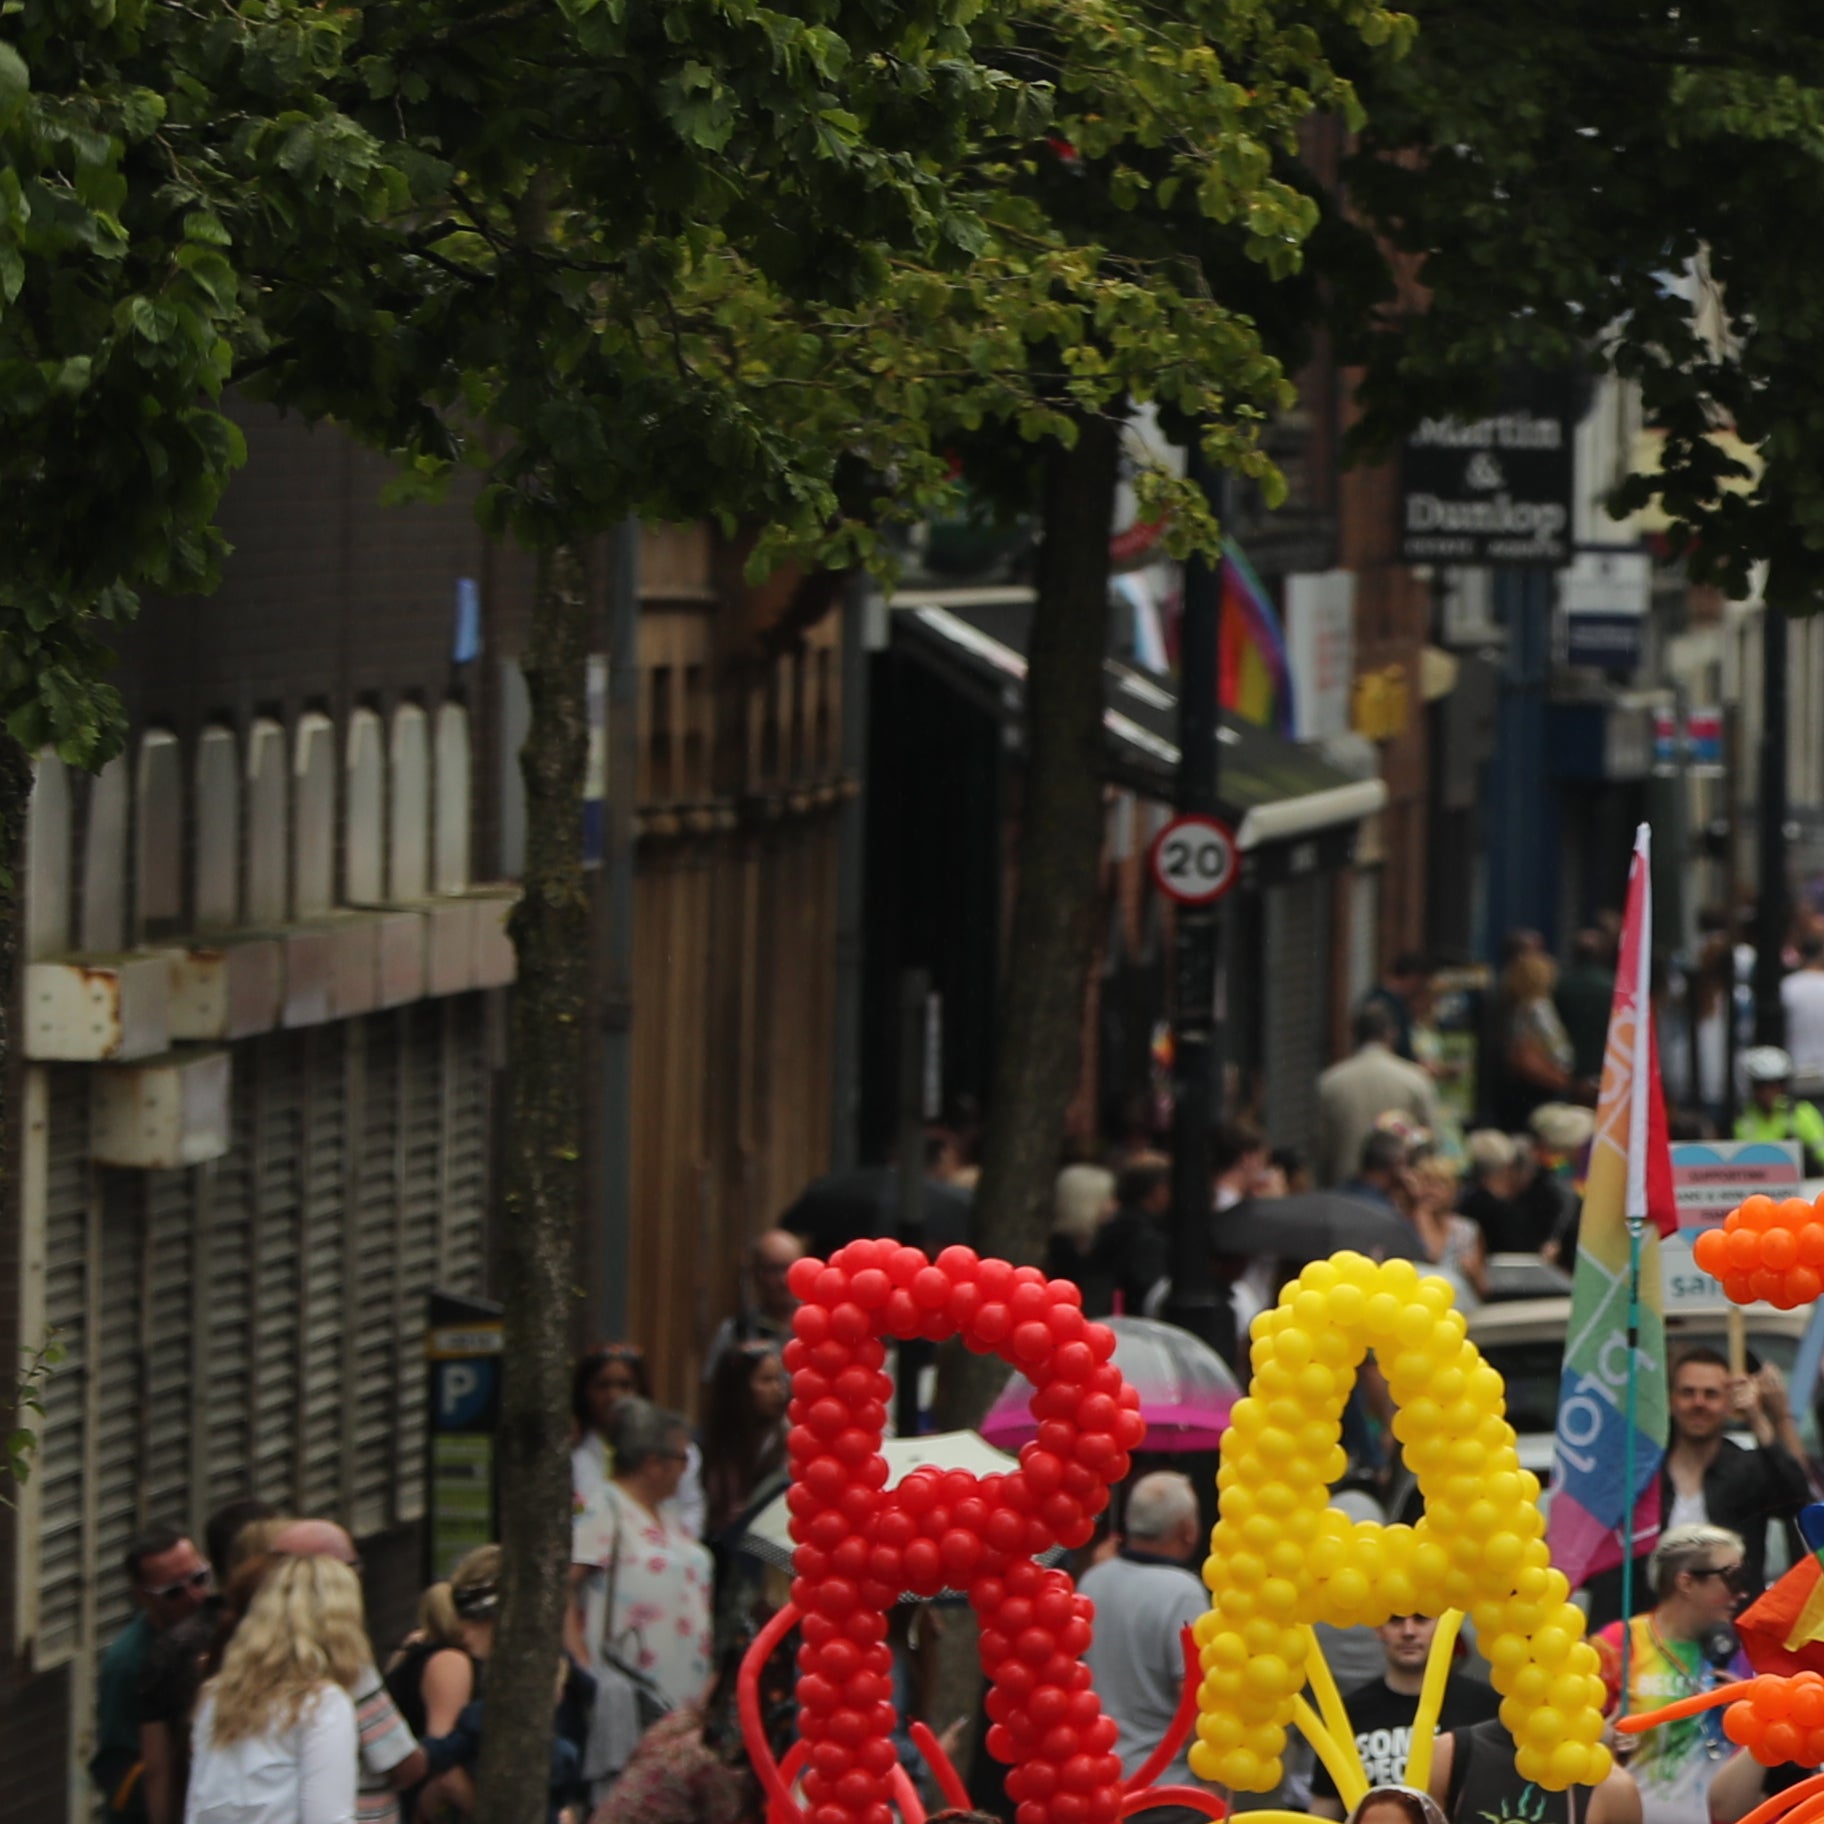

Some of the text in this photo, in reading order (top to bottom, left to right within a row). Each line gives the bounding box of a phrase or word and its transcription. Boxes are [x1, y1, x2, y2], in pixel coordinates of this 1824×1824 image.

[1465, 452, 1504, 490] &
[1406, 493, 1567, 545] Dunlop
[1166, 841, 1225, 879] 20
[1356, 1725, 1415, 1761] SOM
